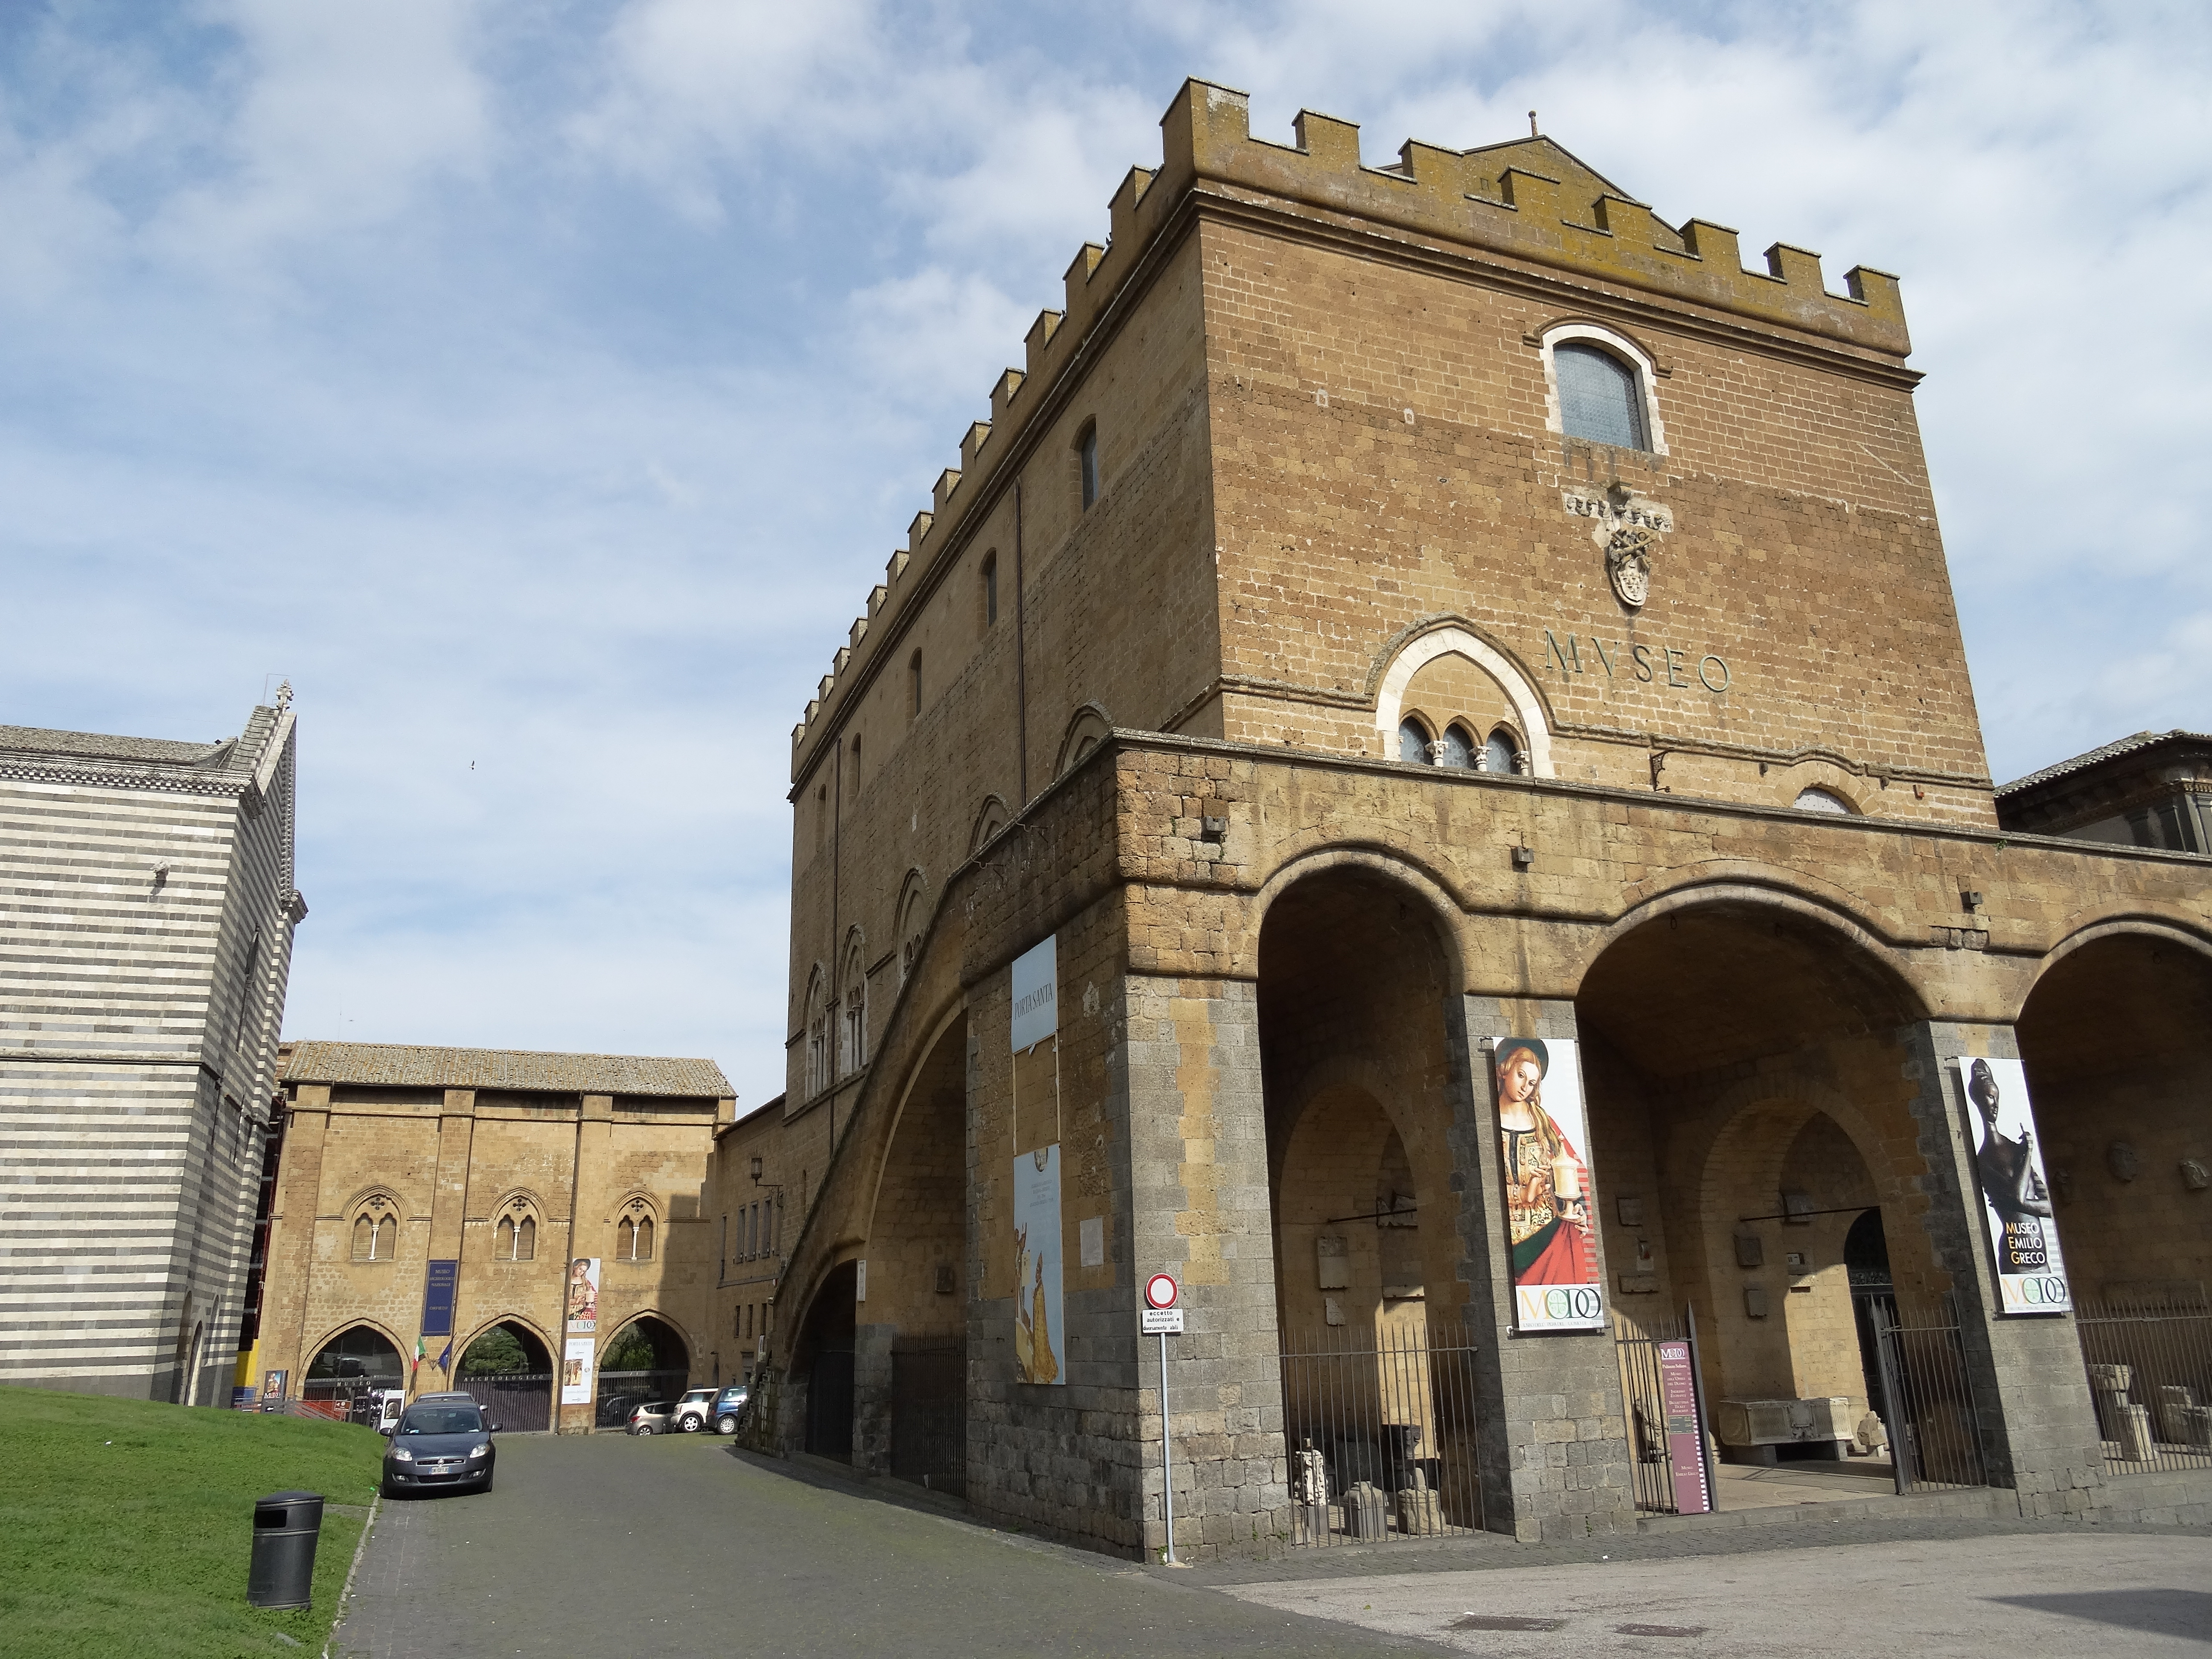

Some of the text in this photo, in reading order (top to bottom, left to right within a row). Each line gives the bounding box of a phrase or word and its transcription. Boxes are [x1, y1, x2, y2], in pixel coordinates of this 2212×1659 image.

[1545, 629, 1731, 692] MVSEO
[1015, 983, 1053, 1020] PORTA SANTA
[2006, 1222, 2040, 1234] MUSEO
[2008, 1237, 2043, 1249] EMILIO
[2011, 1251, 2046, 1265] GRECO
[1519, 1288, 1601, 1320] MODO
